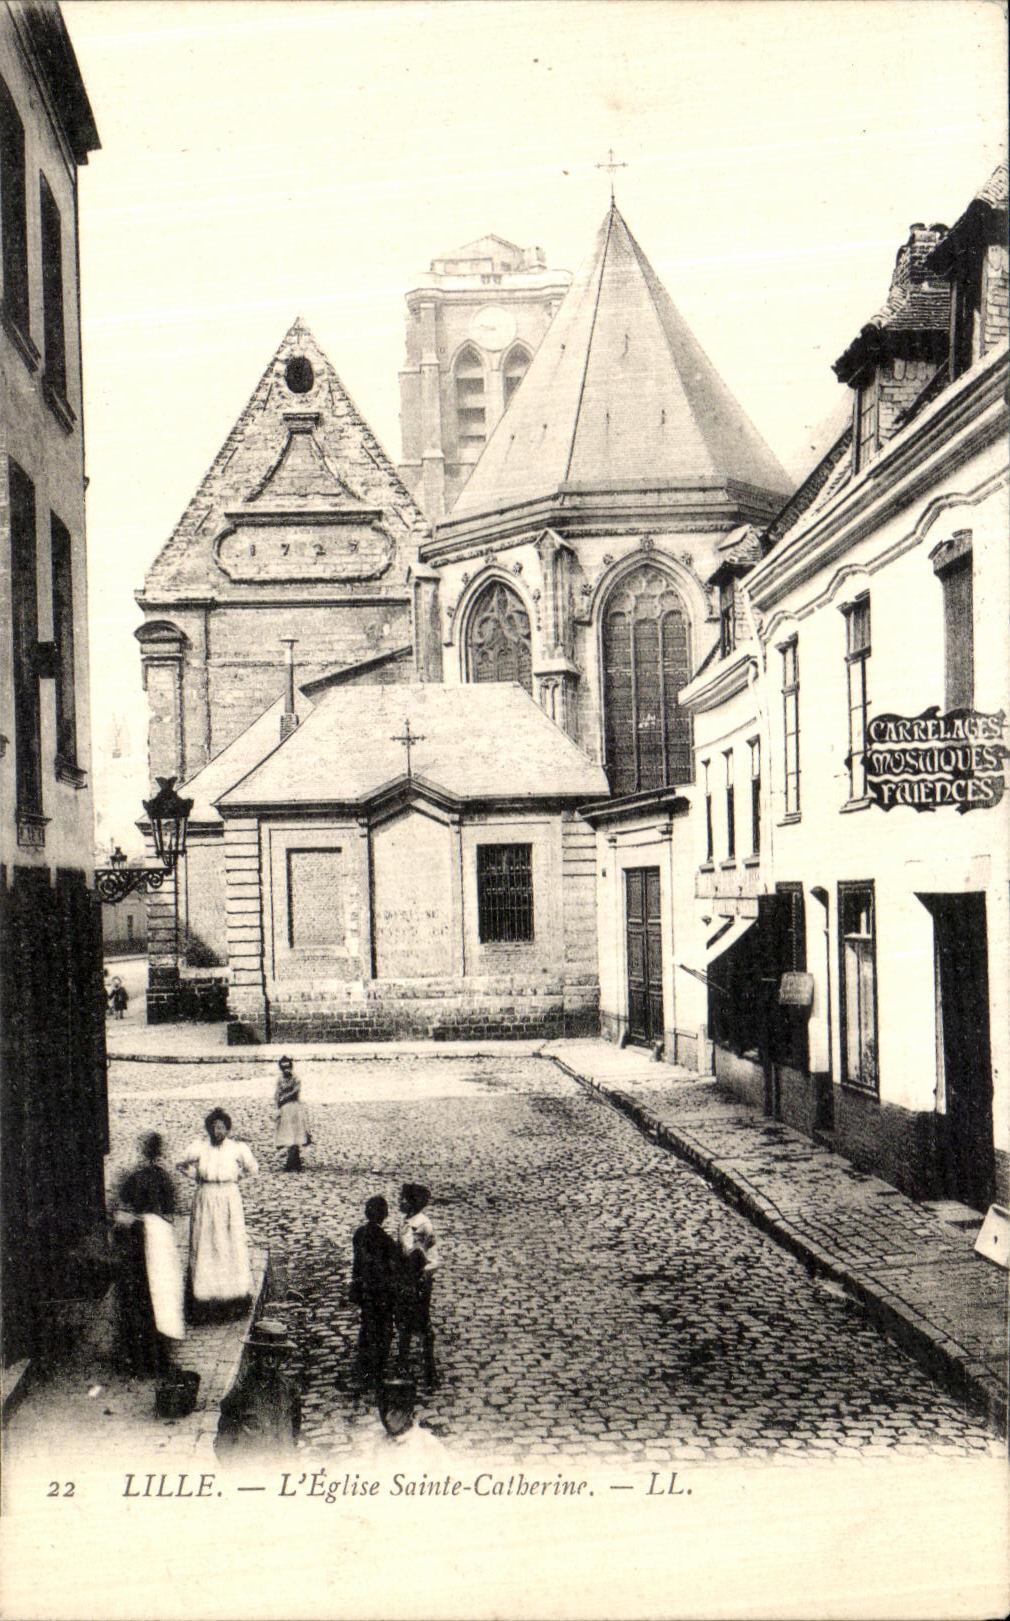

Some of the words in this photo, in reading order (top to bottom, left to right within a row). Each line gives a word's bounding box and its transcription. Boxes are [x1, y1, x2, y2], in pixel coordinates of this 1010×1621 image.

[869, 717, 1001, 741] CARRELAGES
[871, 747, 998, 773] MOSAIQUES
[880, 778, 995, 803] FAIENCES
